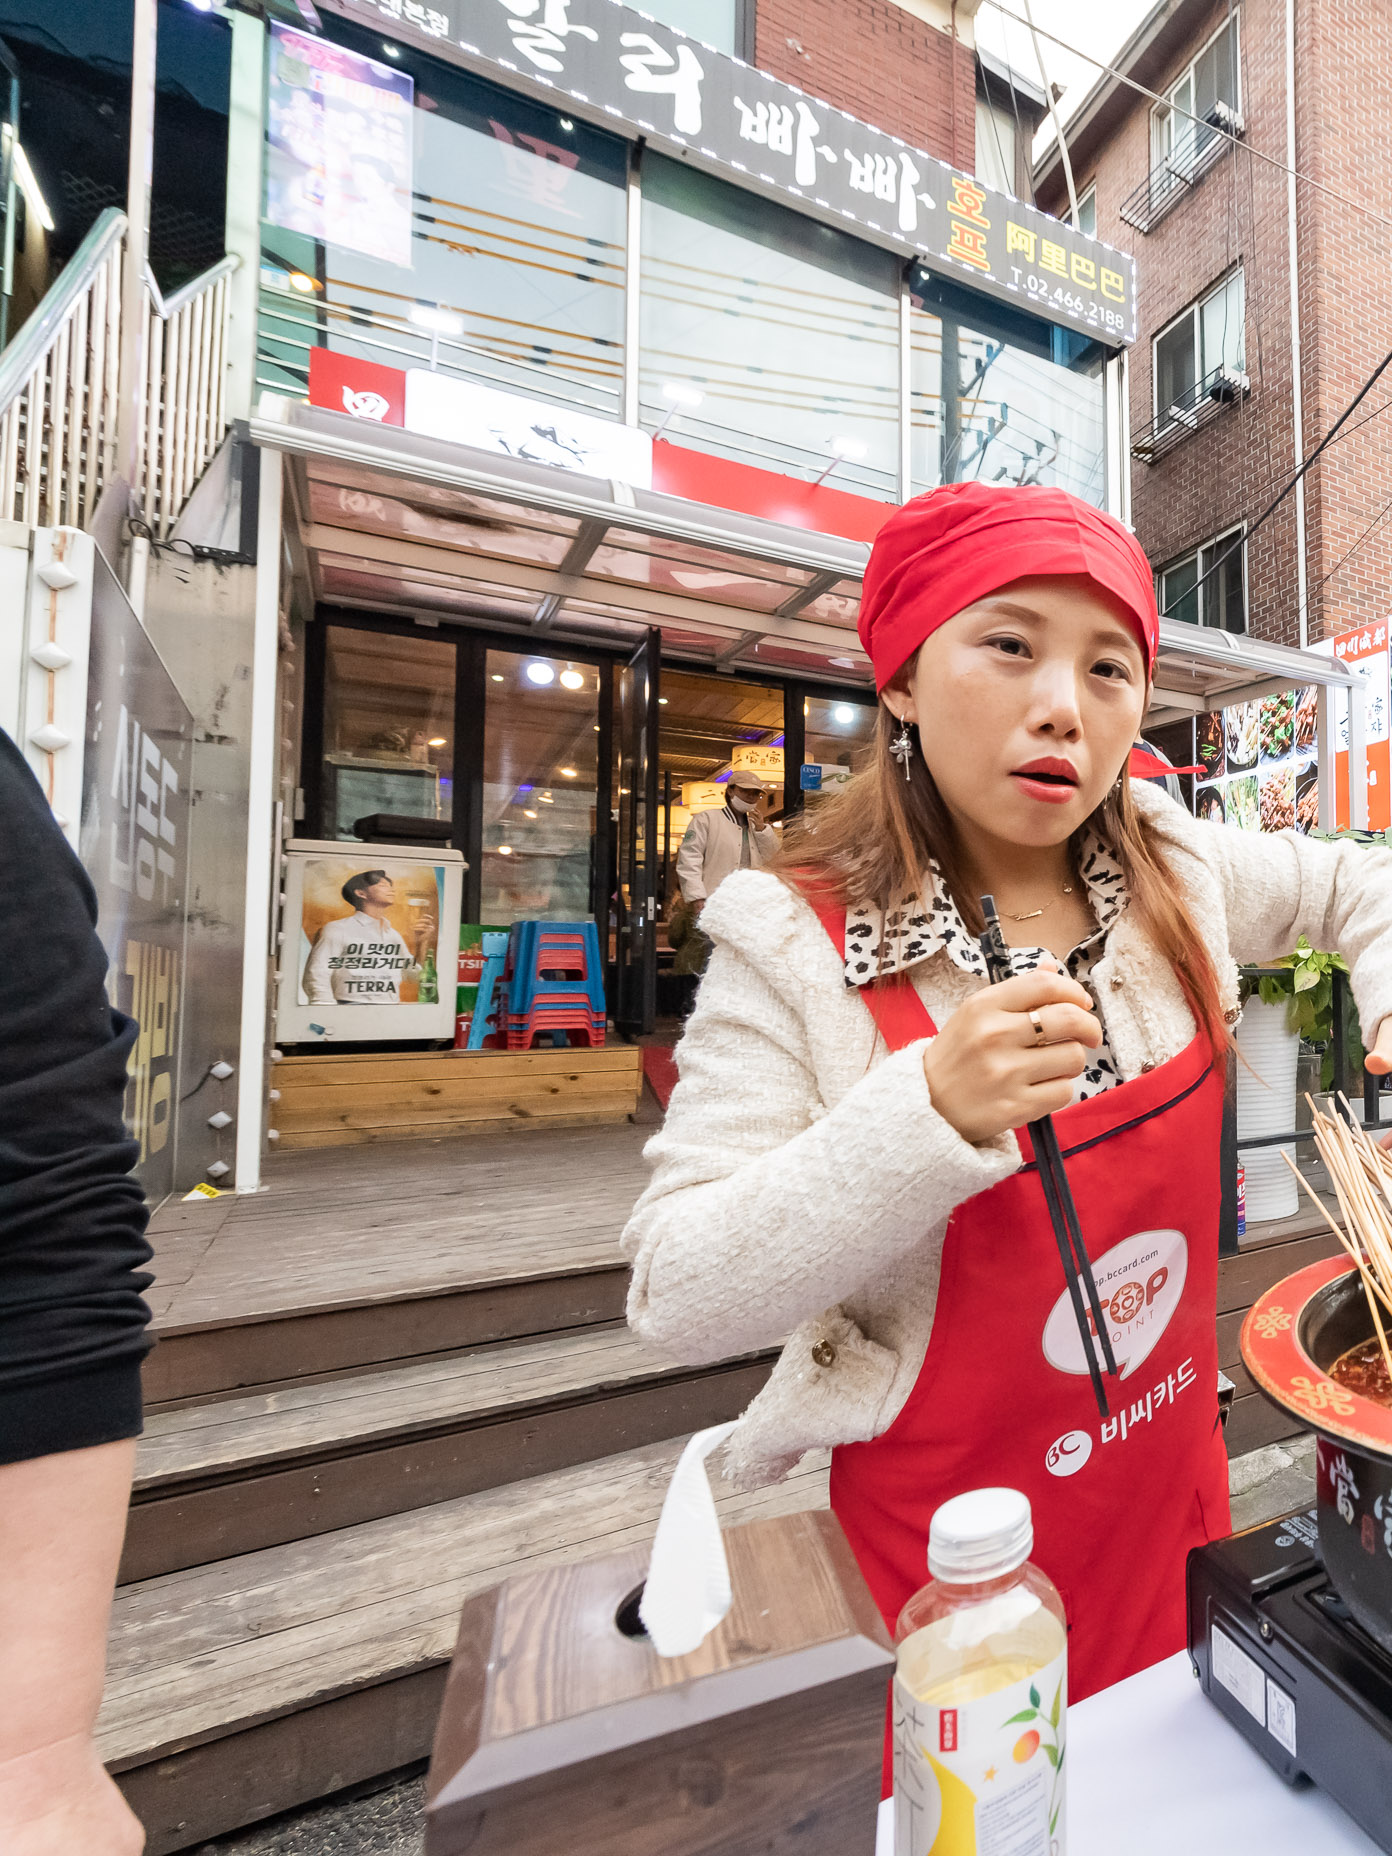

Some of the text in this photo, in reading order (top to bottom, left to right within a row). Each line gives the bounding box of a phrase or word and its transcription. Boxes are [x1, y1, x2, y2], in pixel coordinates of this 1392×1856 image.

[946, 176, 991, 272] 호프
[1006, 220, 1126, 304] 阿里巴巴
[327, 956, 417, 970] 청정라거다!
[346, 943, 401, 956] 이 맛이
[344, 981, 396, 993] TERRA
[1106, 1309, 1154, 1345] OINT
[1101, 1356, 1197, 1445] 비씨카드
[1046, 1433, 1081, 1468] BC
